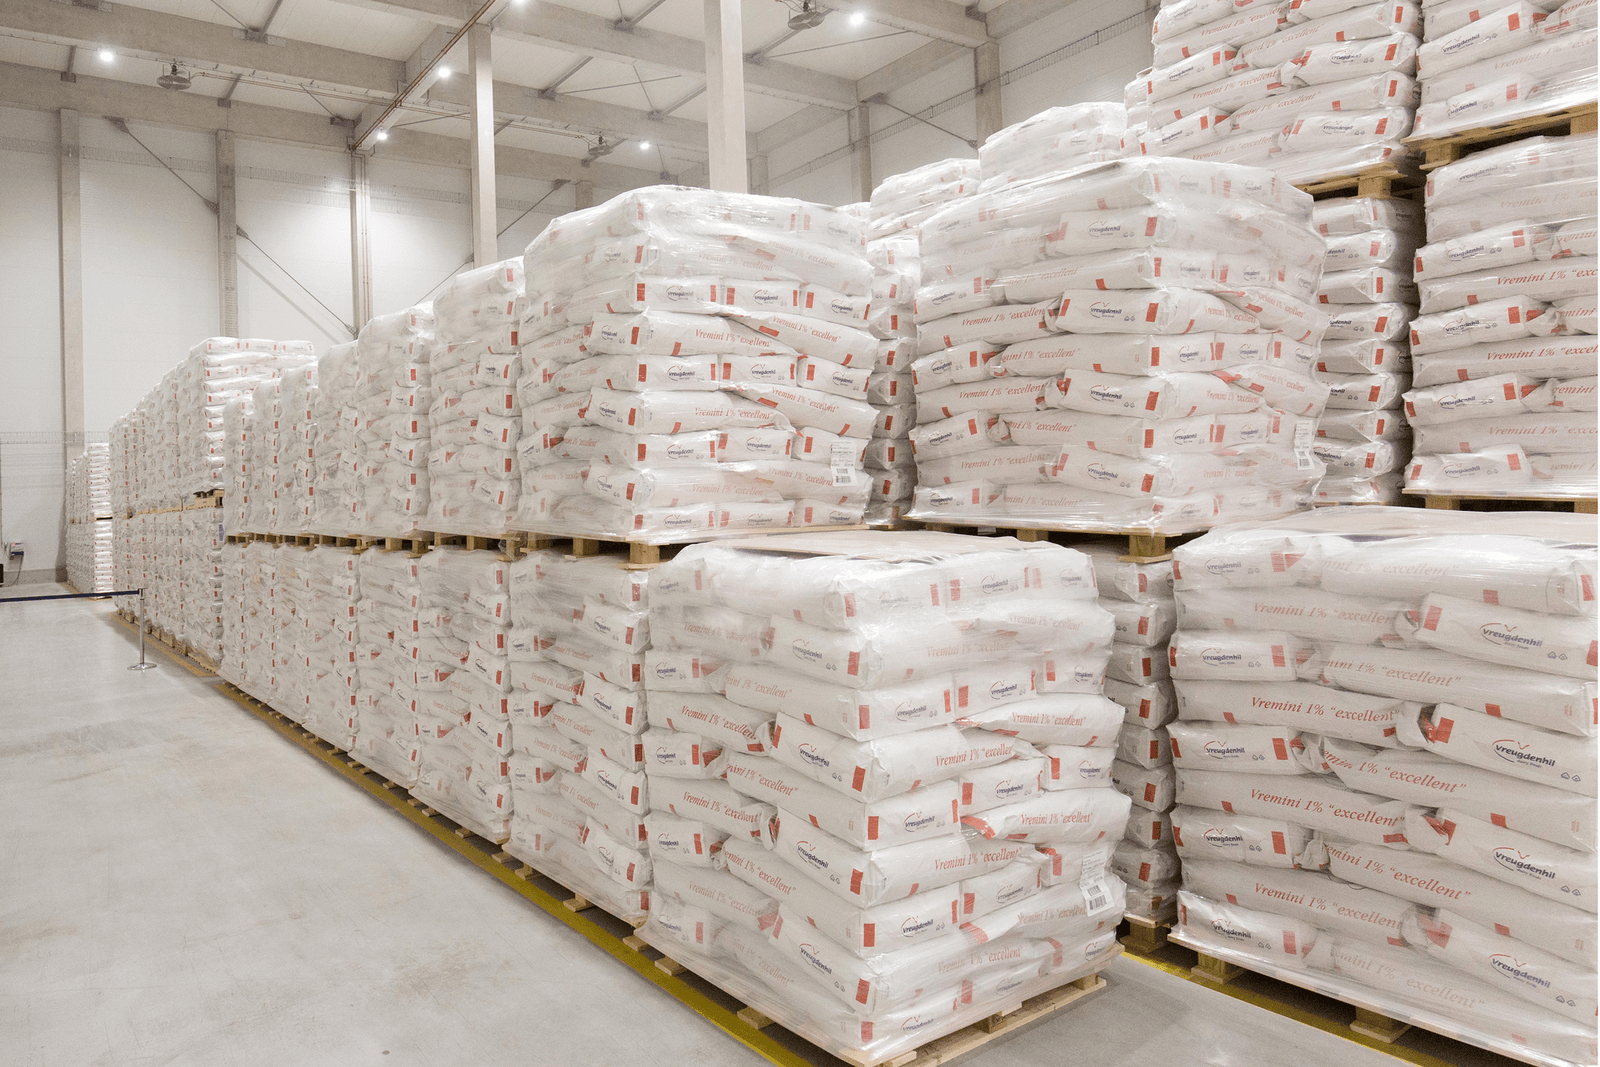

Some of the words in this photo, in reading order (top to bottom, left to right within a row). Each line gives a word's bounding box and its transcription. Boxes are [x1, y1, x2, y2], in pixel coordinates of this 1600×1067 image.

[1498, 272, 1545, 285] Vremini
[1549, 270, 1566, 280] 1%
[773, 316, 798, 330] Vremini
[962, 315, 992, 327] Vremini
[994, 313, 1005, 321] 1%
[695, 329, 723, 340] Vremini
[725, 332, 735, 340] 1%
[1022, 350, 1034, 359] 1%
[1487, 349, 1534, 360] Vremini
[1539, 348, 1555, 357] 1%
[772, 387, 796, 401] Vremini
[959, 388, 989, 399] Vremini
[990, 388, 1001, 396] 1%
[1554, 385, 1596, 394] remini
[695, 407, 723, 416] Vremini
[1489, 427, 1535, 435] Vremini
[1540, 426, 1557, 434] 1%
[961, 458, 990, 468] Vremini
[1253, 602, 1305, 616] Vremini
[1308, 607, 1328, 619] 1%
[1483, 628, 1543, 648] vreugdenhil
[1355, 661, 1375, 675] 1%
[1252, 697, 1302, 713] Vremini
[1305, 702, 1325, 716] 1%
[681, 706, 708, 721] Vremini
[710, 713, 719, 726] 1%
[1012, 712, 1039, 725] Vremini
[1039, 713, 1049, 724] 1%
[935, 751, 967, 767] Vremini
[969, 746, 980, 760] 1%
[1495, 744, 1556, 767] vreugdenhil
[747, 767, 757, 781] 1%
[1358, 761, 1379, 775] 1%
[682, 791, 710, 808] Vremini
[711, 798, 721, 812] 1%
[1251, 789, 1302, 808] Vremini
[1304, 799, 1324, 814] 1%
[1021, 814, 1047, 825] Vremini
[1049, 814, 1059, 824] 1%
[1206, 835, 1243, 843] vreugdenhi
[744, 859, 755, 874] 1%
[934, 855, 965, 871] Vremini
[967, 851, 978, 866] 1%
[1363, 860, 1384, 875] 1%
[1495, 851, 1556, 880] vreugdenhil
[689, 881, 715, 900] Vremini
[1254, 883, 1304, 905] Vremini
[1307, 896, 1327, 911] 1%
[1492, 958, 1551, 988] vreugdenhil
